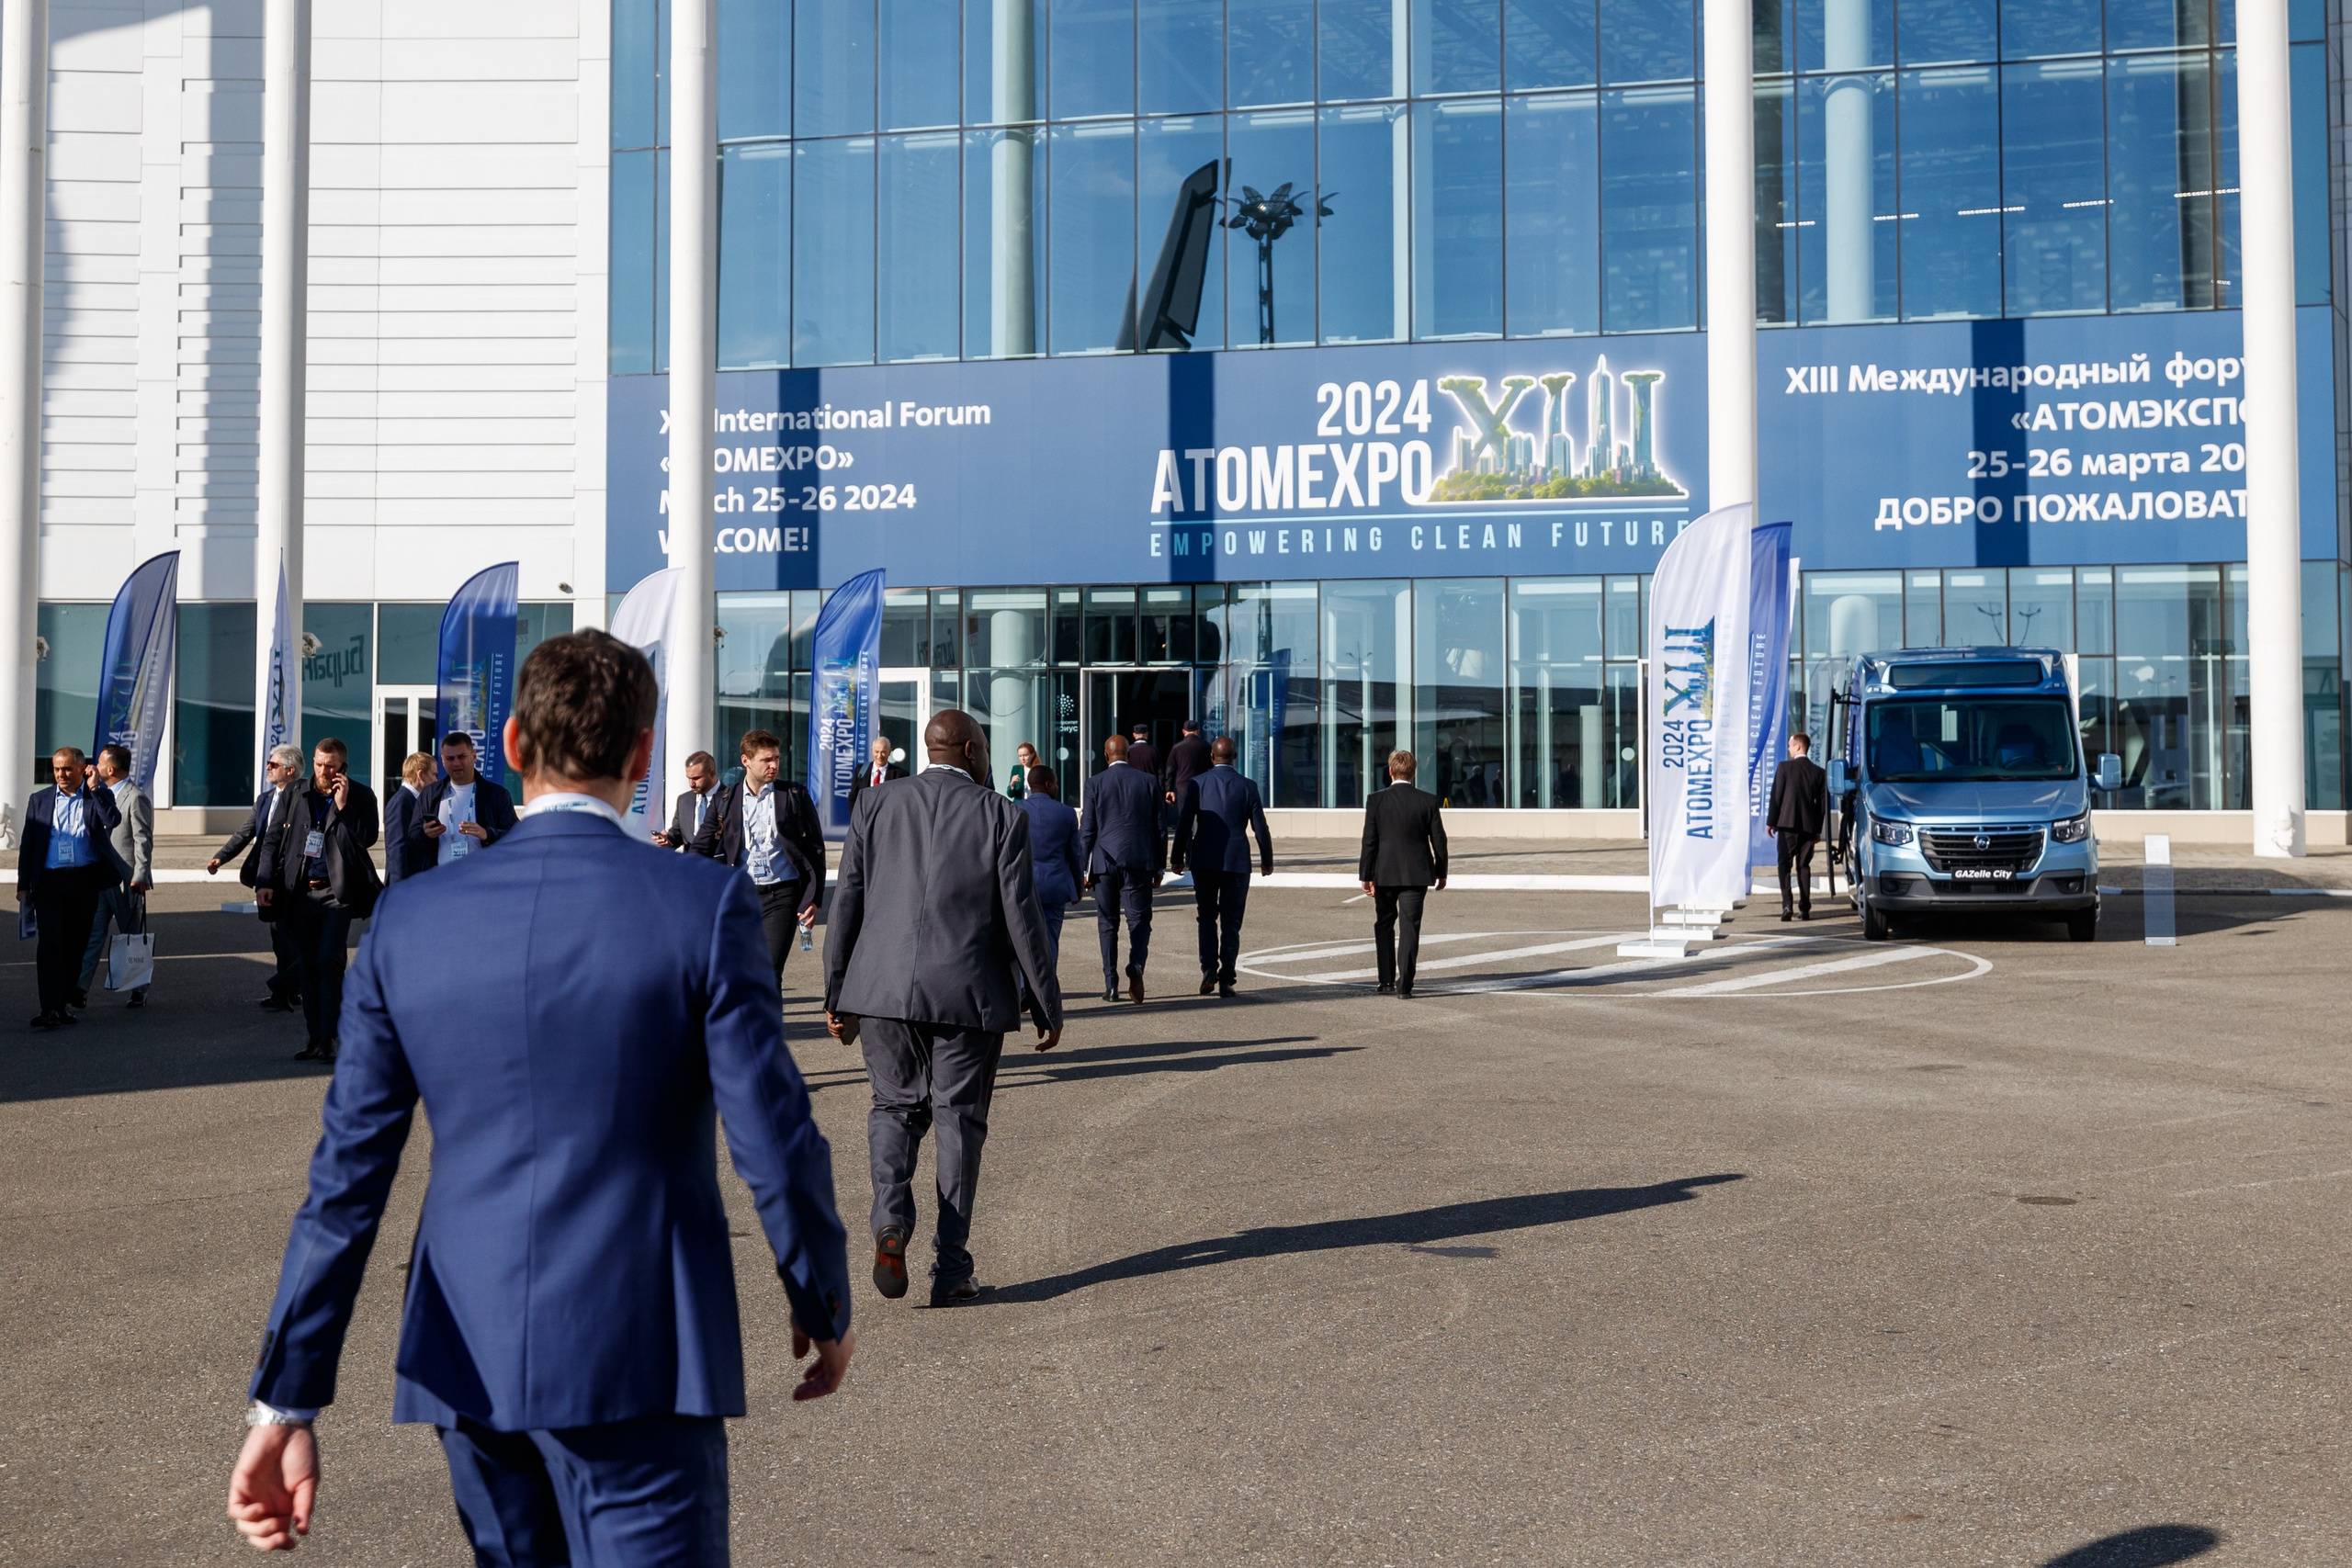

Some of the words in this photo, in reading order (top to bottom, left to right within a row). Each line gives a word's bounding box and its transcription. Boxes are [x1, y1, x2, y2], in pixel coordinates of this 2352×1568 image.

[1785, 366, 1838, 394] XIII
[1848, 354, 2151, 397] Международный
[2165, 352, 2245, 388] фор
[714, 401, 891, 432] International
[899, 401, 990, 426] Forum
[1317, 379, 1431, 436] 2024
[2010, 397, 2245, 432] «АТОМЭКСП
[660, 445, 854, 473] «OMEXPO»
[1150, 441, 1432, 513] ATOMEXPO
[2081, 453, 2189, 482] марта
[2200, 443, 2245, 473] 20
[843, 483, 916, 510] 2024
[1875, 496, 2004, 531] ДОБРО
[2014, 490, 2248, 524] ПОЖАЛОВАТ
[659, 527, 809, 554] COME!
[1150, 527, 1383, 558] EMPOWERING
[1411, 524, 1521, 550] CLEAN
[1721, 613, 1732, 671] FUTURE
[1753, 633, 1766, 685] FUTURE
[494, 652, 503, 694] FUTURE
[861, 650, 869, 689] FUTURE
[144, 702, 154, 739] CLEAN
[149, 648, 159, 694] FUTURE
[859, 694, 868, 727] CLEAN
[1721, 681, 1732, 728] CLEAN
[492, 702, 501, 738] CLEAN
[820, 717, 835, 750] 2024
[1751, 694, 1762, 739] CLEAN
[485, 745, 496, 778] ERING
[834, 718, 855, 798] ATOMEXPO
[858, 733, 866, 763] ERING
[1663, 719, 1684, 768] 2024
[1687, 719, 1713, 840] ATOMEXPO
[1721, 739, 1732, 840] EMPOWERING
[1955, 869, 1991, 879] GAZelle
[1993, 869, 2012, 880] City
